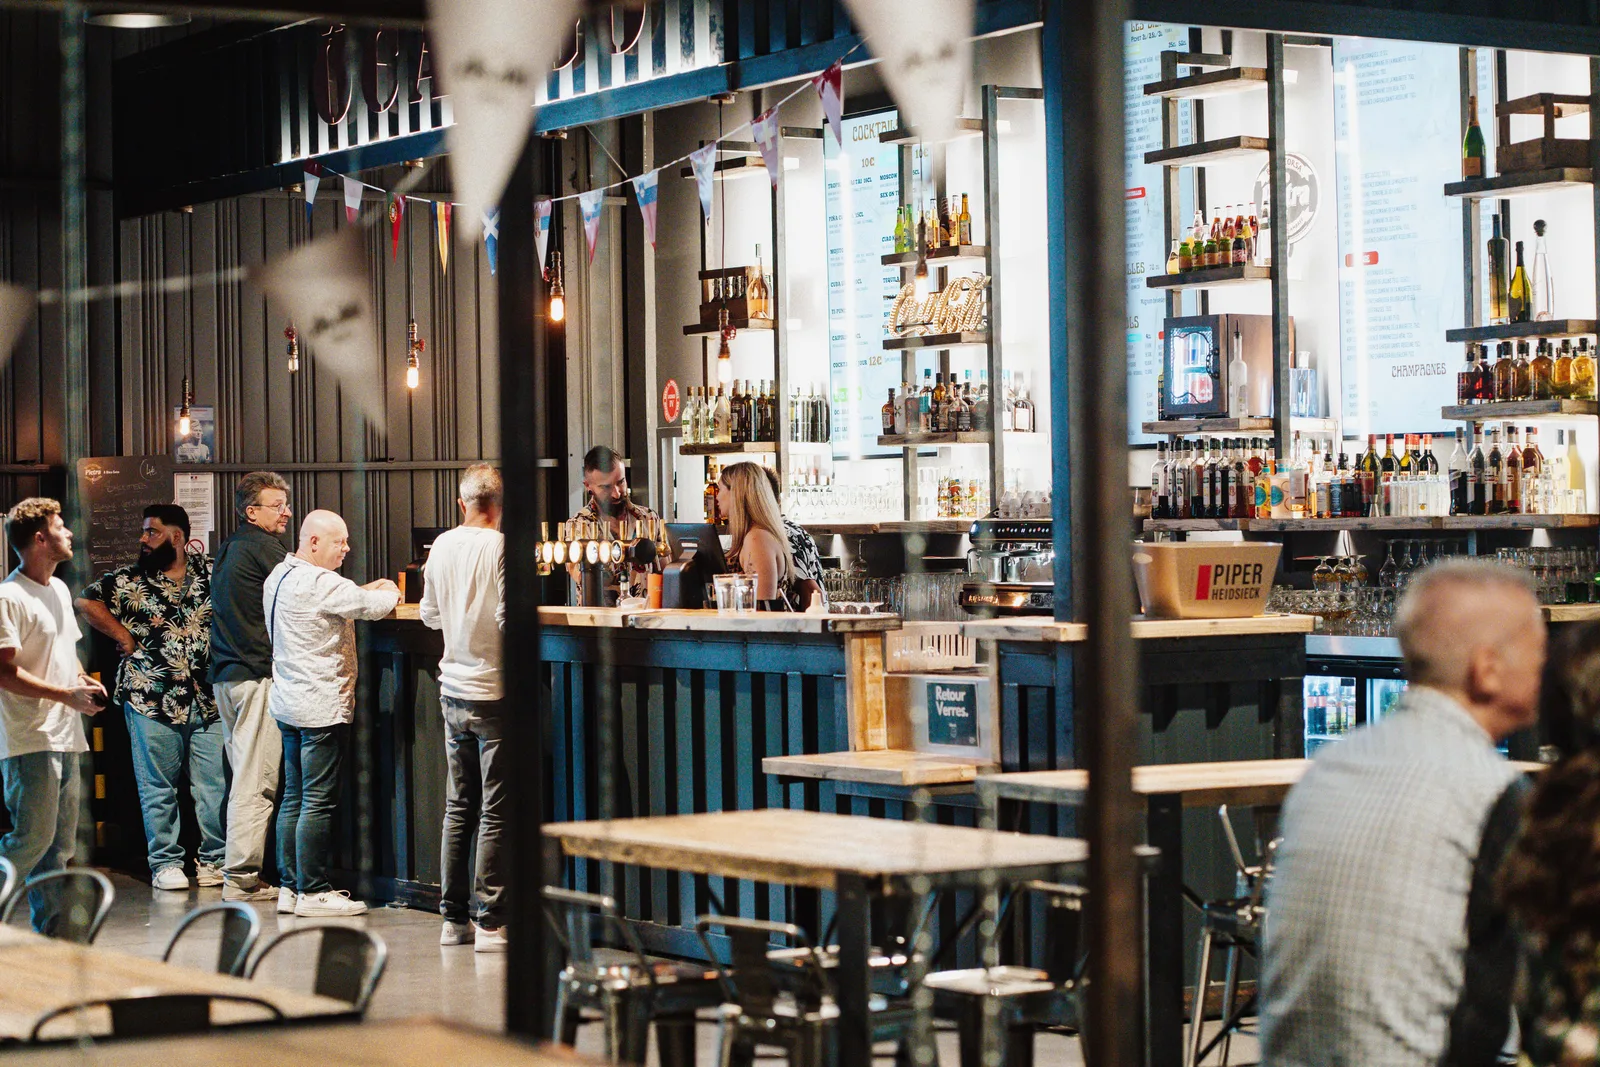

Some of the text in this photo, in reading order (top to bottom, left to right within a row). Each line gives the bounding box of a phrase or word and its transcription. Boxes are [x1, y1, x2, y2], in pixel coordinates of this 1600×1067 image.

[852, 119, 898, 142] COCKTAIL
[1391, 362, 1447, 378] CHAMPAGNES
[1213, 563, 1263, 586] PIPER
[1211, 587, 1260, 600] HEIDSIECK
[935, 685, 966, 701] Retour
[935, 702, 969, 718] Verres.
